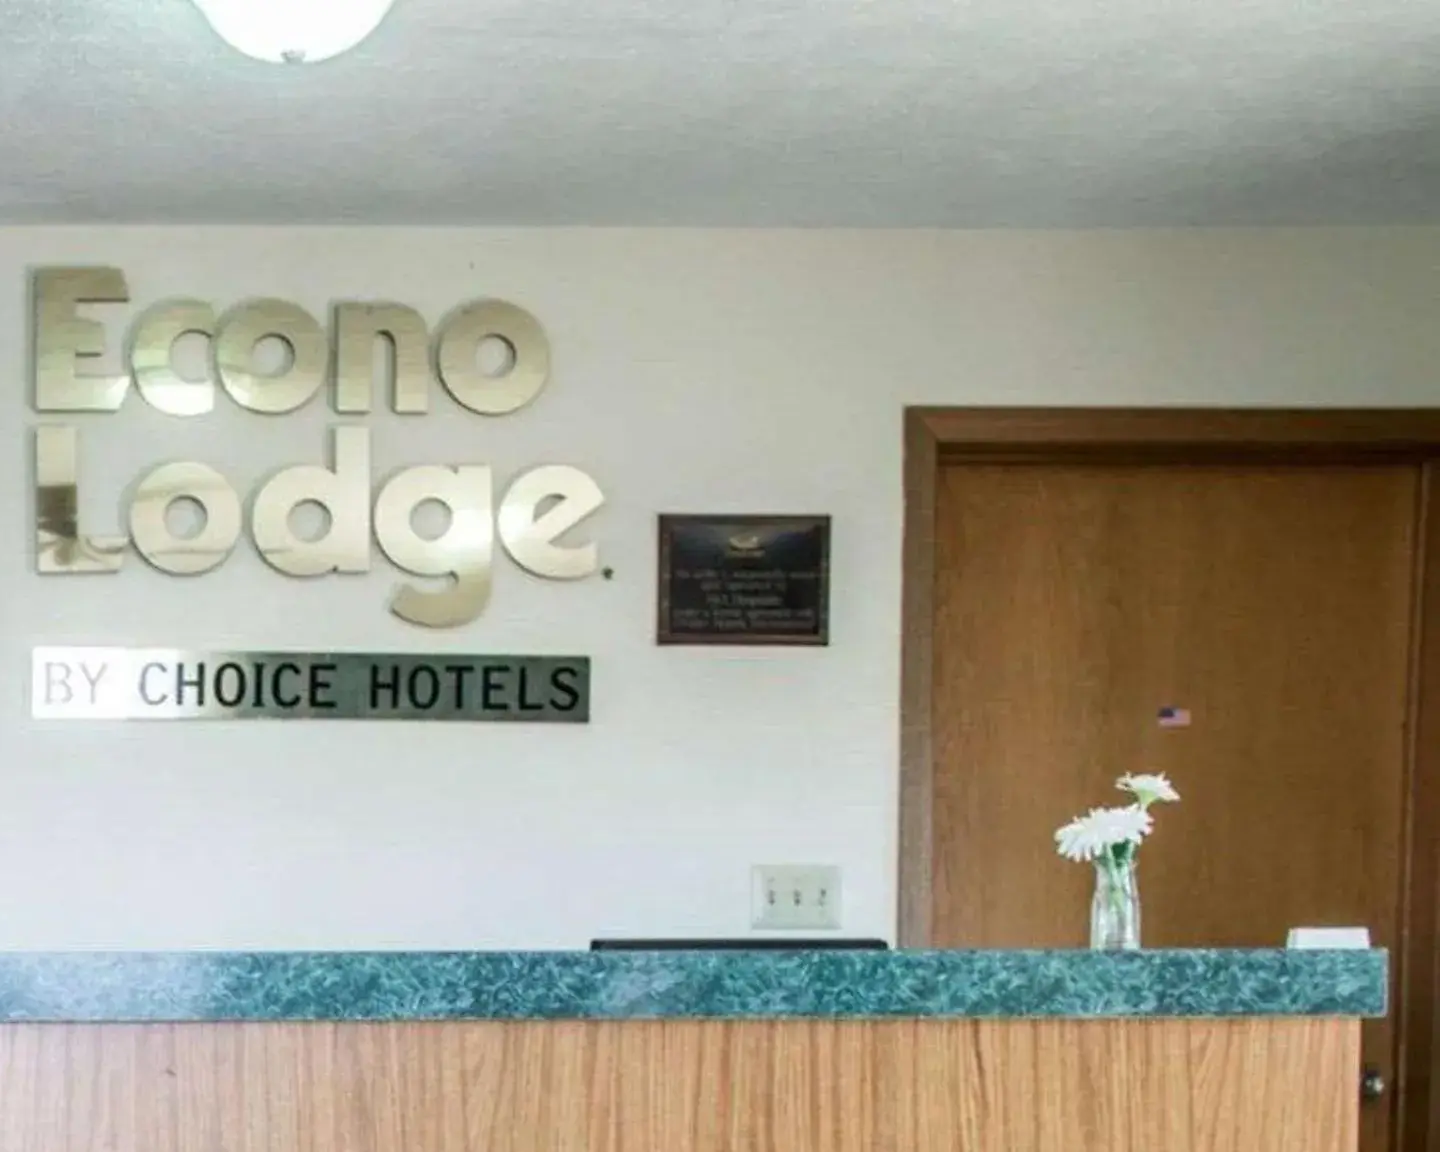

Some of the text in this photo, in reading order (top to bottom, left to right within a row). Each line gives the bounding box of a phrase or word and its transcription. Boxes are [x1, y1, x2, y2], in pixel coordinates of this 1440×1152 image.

[33, 265, 551, 417] Econo
[44, 661, 581, 713] BY CHOICE HOTELS
